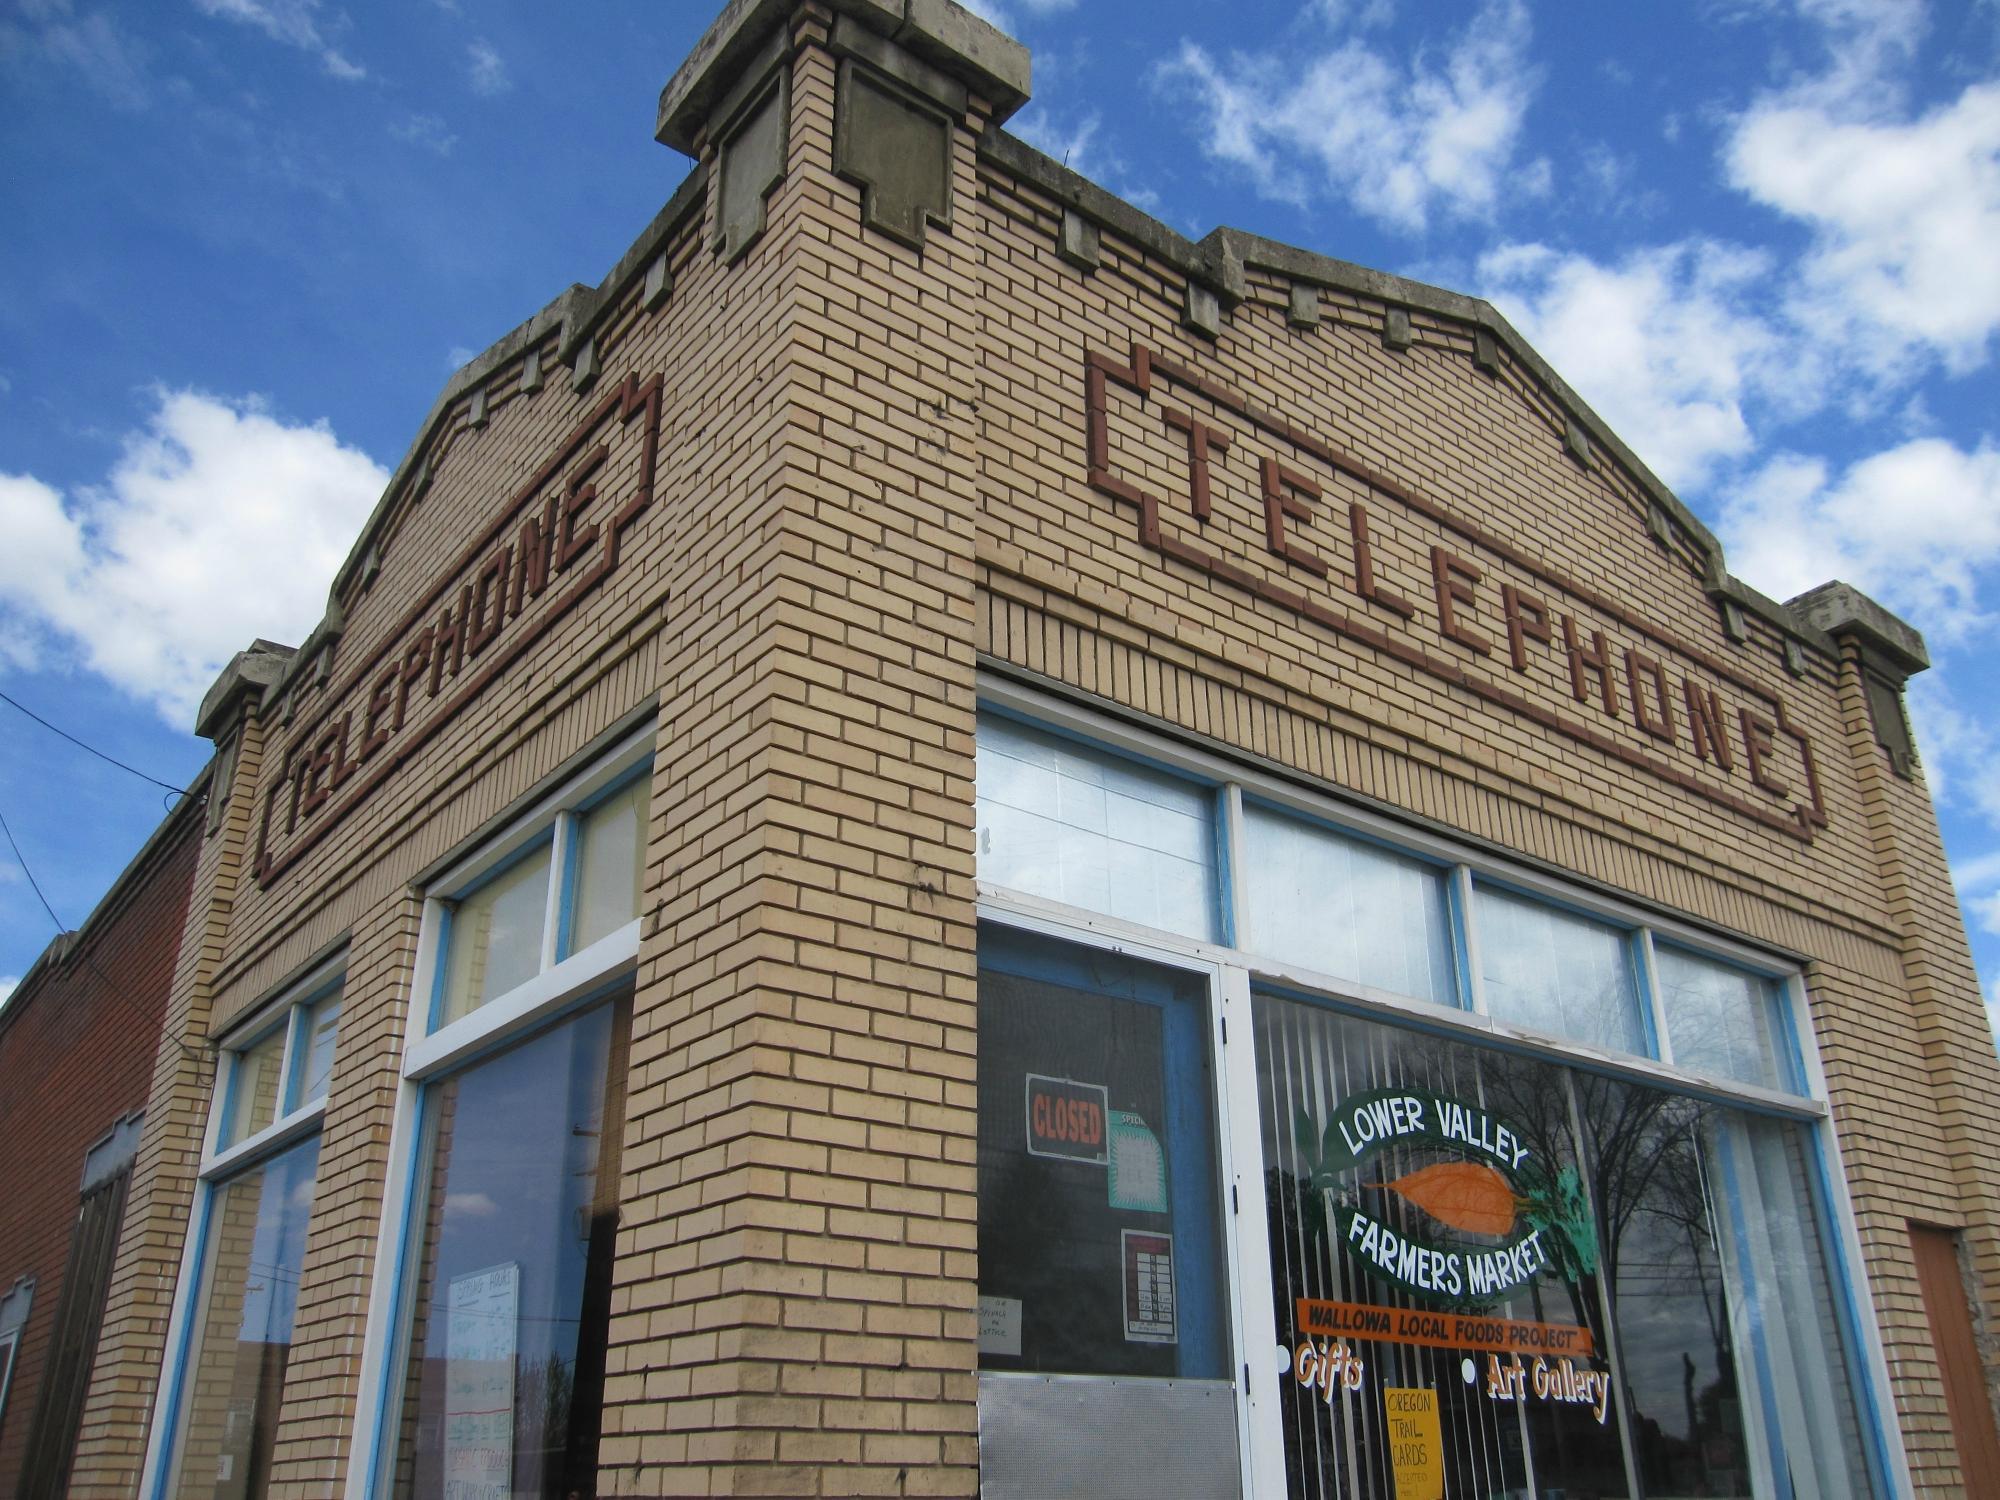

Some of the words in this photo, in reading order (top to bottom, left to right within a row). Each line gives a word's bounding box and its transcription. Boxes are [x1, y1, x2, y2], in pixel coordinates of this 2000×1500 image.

[1161, 405, 1789, 800] TELEPHONE
[283, 444, 609, 835] TELEPHONE
[1033, 1093, 1100, 1145] CLOSED
[1338, 1096, 1425, 1156] LOWER
[1434, 1099, 1529, 1170] VALLEY
[1349, 1211, 1462, 1296] FARMERS
[1465, 1230, 1546, 1295] MARKET
[1308, 1304, 1391, 1334] WALLOWA
[1398, 1314, 1449, 1341] LOCAL
[1455, 1319, 1504, 1344] FOODS
[1509, 1325, 1578, 1349] PROJECT
[1295, 1340, 1364, 1405] Gifts
[1388, 1393, 1431, 1412] OREGON
[1487, 1353, 1527, 1401] Art
[1532, 1355, 1610, 1425] Gallery
[1391, 1418, 1424, 1438] TRAIL
[1393, 1443, 1428, 1467] CARDS
